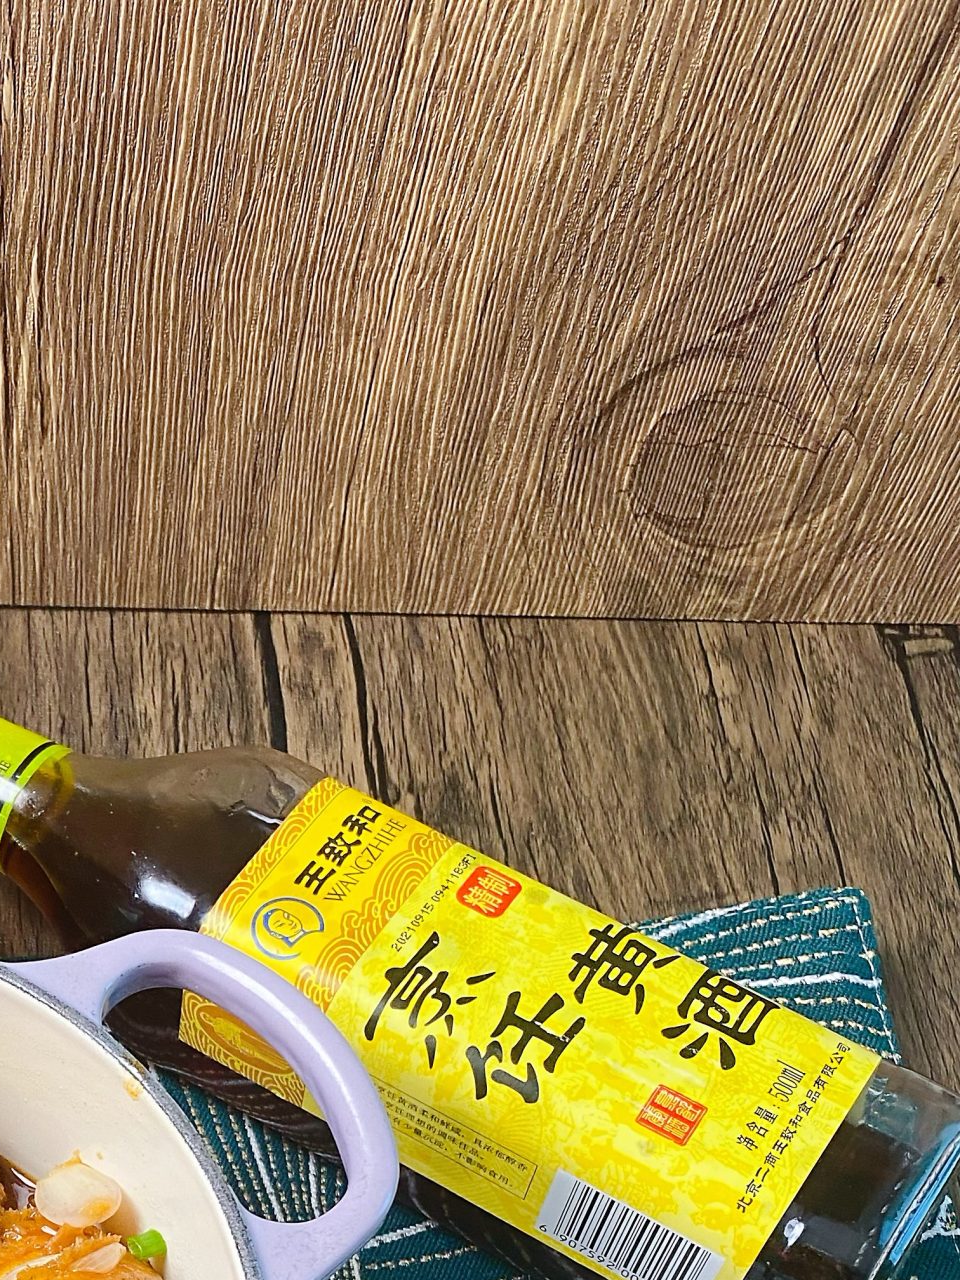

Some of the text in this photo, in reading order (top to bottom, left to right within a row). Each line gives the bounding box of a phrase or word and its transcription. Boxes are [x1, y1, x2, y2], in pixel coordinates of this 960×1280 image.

[294, 804, 383, 896] 王致和
[324, 817, 407, 902] WANGZHIHE
[463, 870, 517, 915] 精制
[391, 902, 434, 953] 20210915
[736, 1042, 851, 1213] 北京二商王致和食品有限公司
